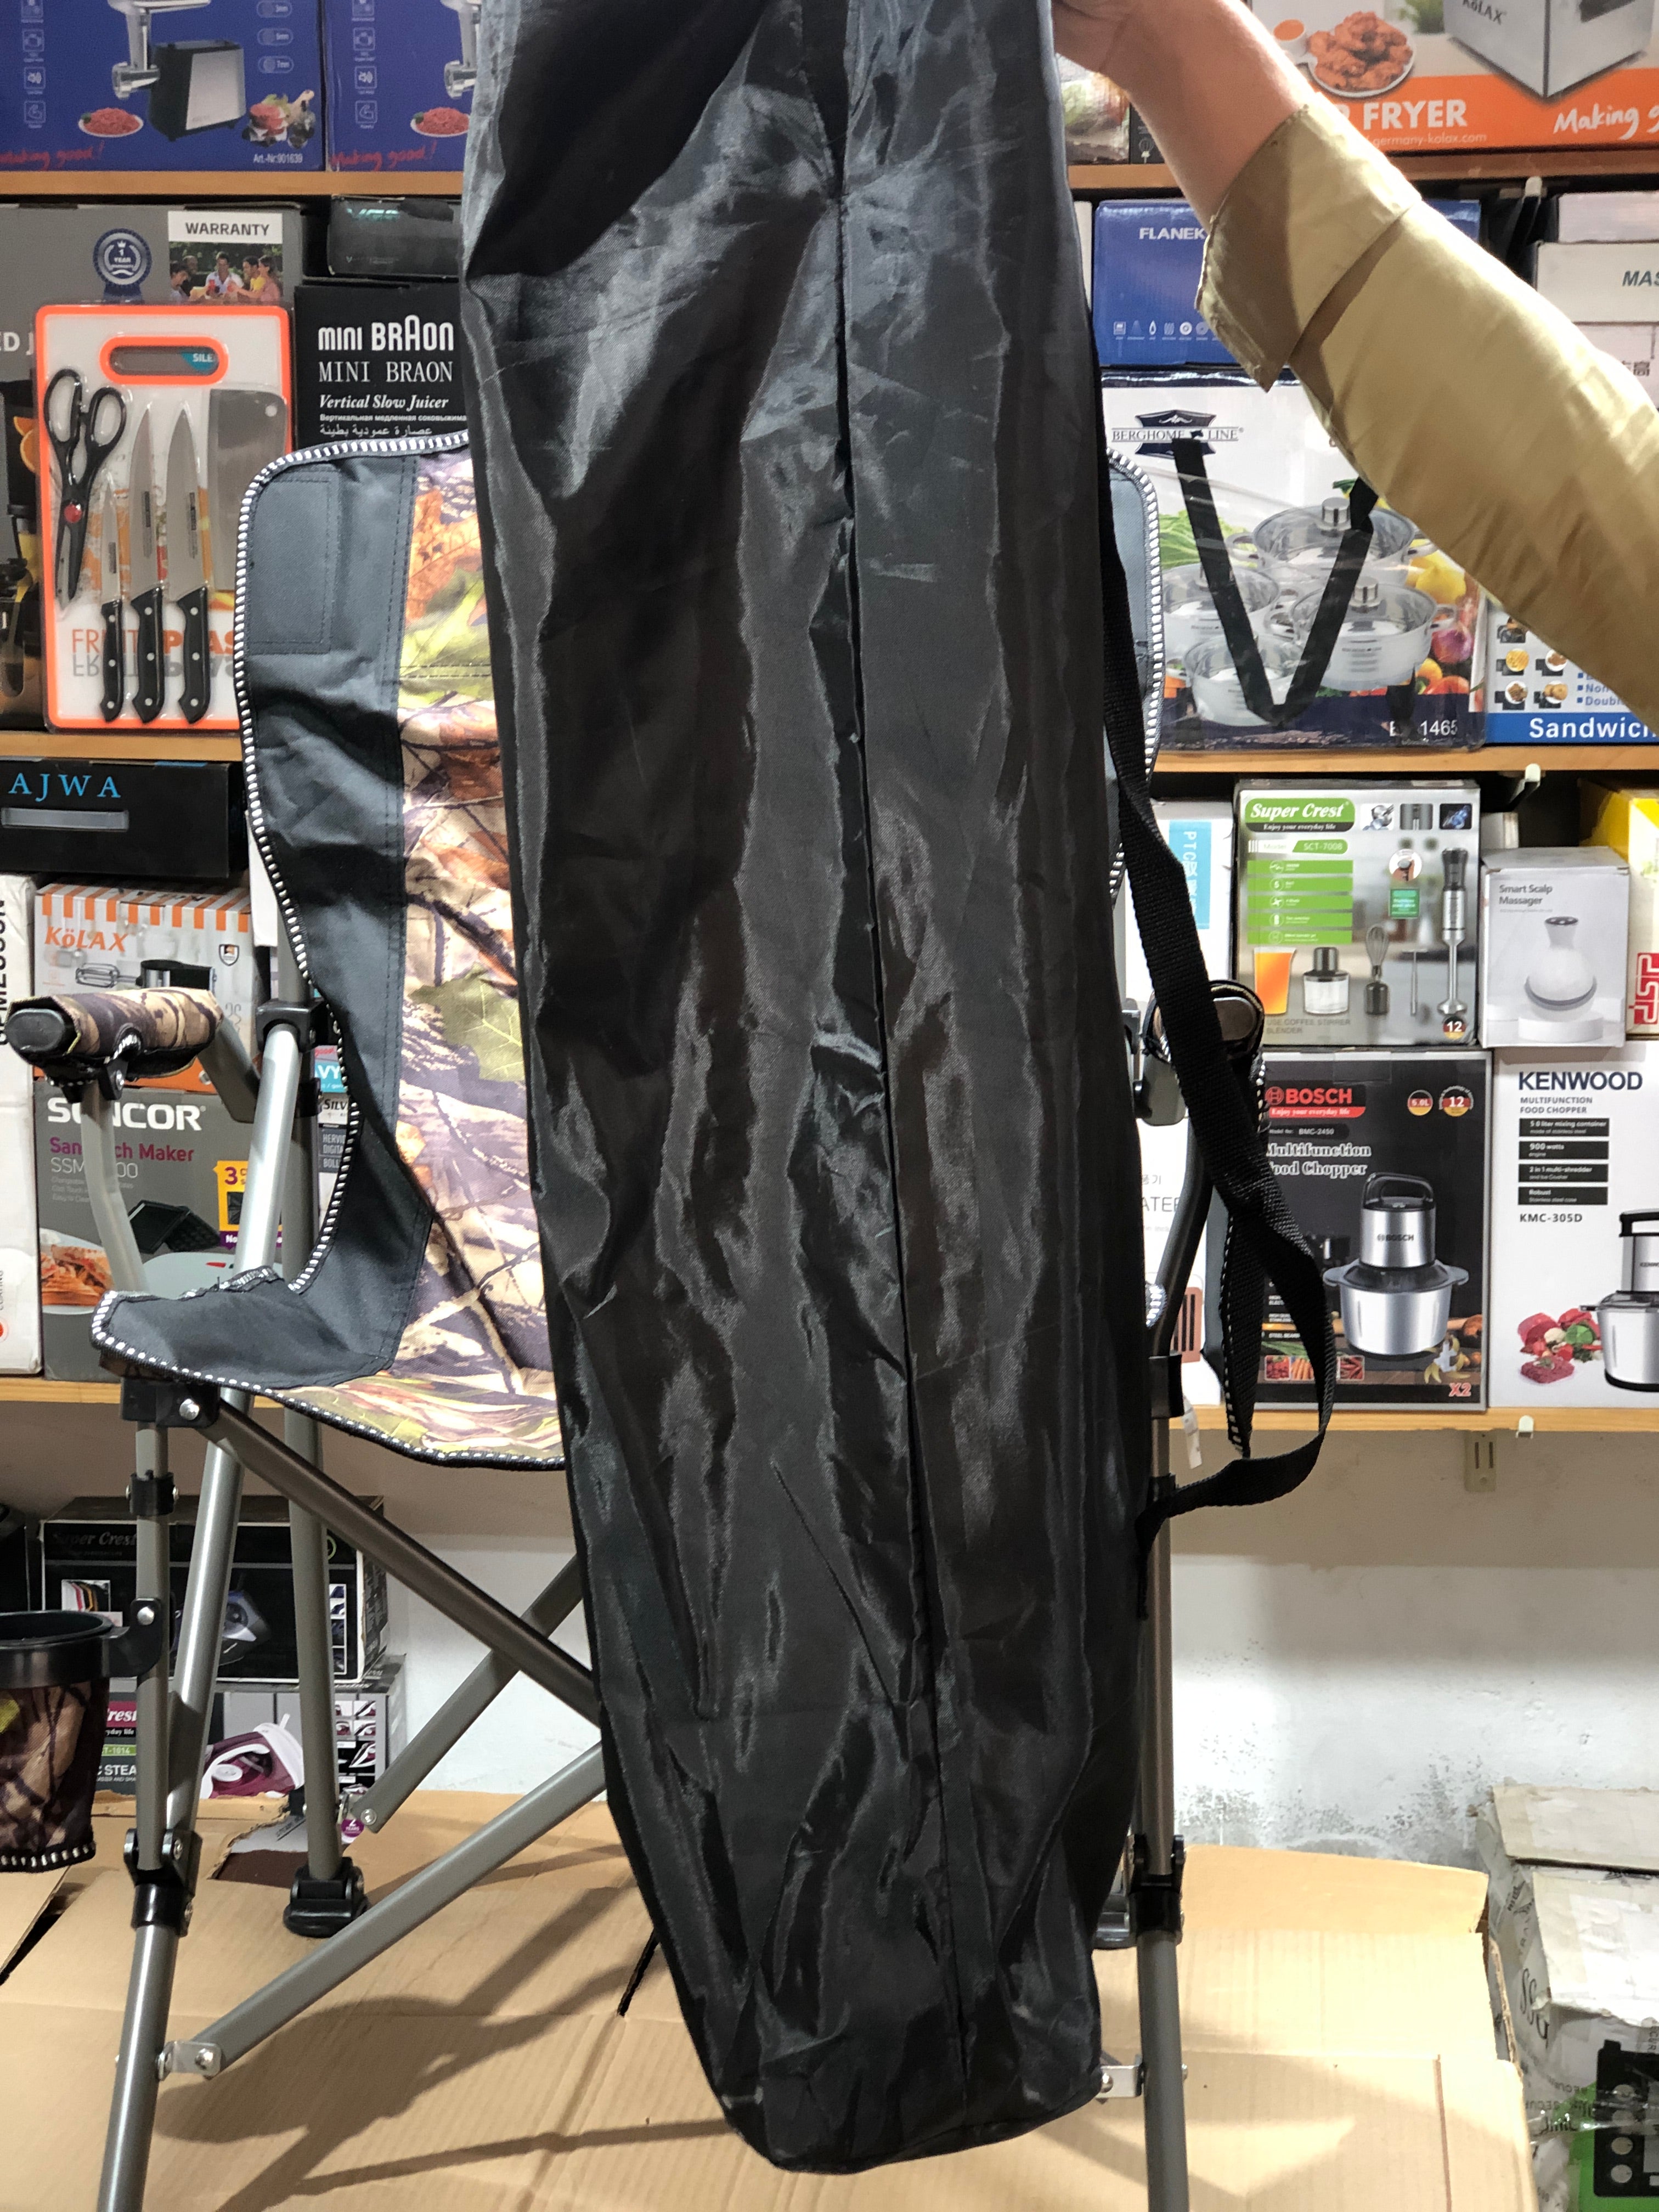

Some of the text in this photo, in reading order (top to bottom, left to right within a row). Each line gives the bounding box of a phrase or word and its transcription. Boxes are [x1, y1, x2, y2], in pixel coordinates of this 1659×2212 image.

[1363, 100, 1468, 131] FRYER
[1554, 106, 1639, 140] Making
[1368, 133, 1487, 150] germany-kolax.com
[185, 222, 270, 236] WARRANTY
[371, 314, 454, 352] BRAON
[318, 361, 454, 382] MINI BRAON
[319, 394, 449, 412] Vertical Slow Juicer
[1208, 429, 1238, 440] LINE
[1420, 720, 1458, 736] 1465
[8, 772, 121, 802] AJWA
[1250, 803, 1344, 821] Super Crest
[1499, 884, 1553, 895] Smart Scalp
[1499, 896, 1543, 907] Massager
[45, 926, 128, 953] KöLAX
[1446, 1020, 1462, 1032] 12
[1518, 1071, 1643, 1091] KENWOOD
[1285, 1087, 1352, 1105] BOSCH
[1449, 1096, 1465, 1108] 12
[47, 1097, 203, 1131] SCOR
[49, 1136, 195, 1162] Sanch Maker
[224, 1166, 238, 1185] 3
[1269, 1160, 1368, 1180] ood Chopper
[1519, 1214, 1583, 1223] KMC-305D
[1449, 1383, 1472, 1397] X2
